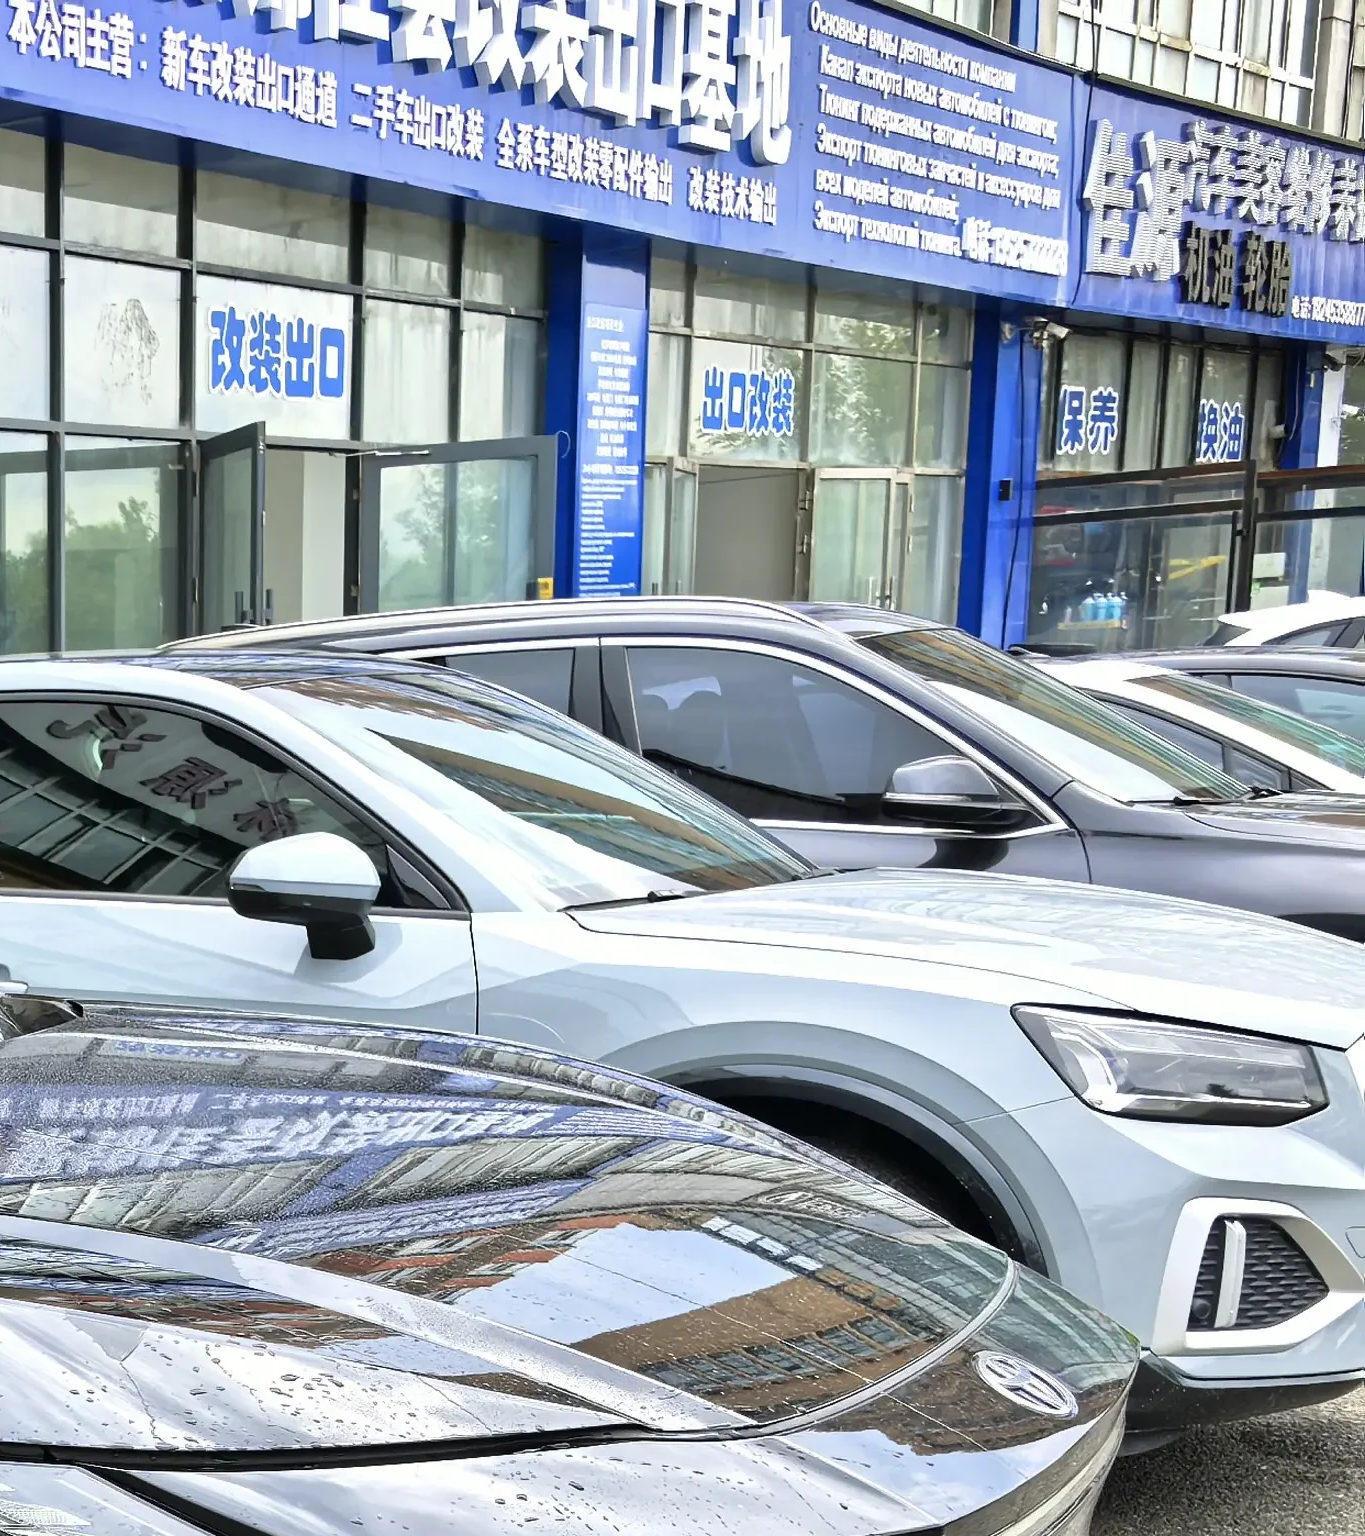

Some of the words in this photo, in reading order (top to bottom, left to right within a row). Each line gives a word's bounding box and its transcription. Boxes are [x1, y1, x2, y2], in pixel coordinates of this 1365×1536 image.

[811, 0, 867, 47] Основные
[869, 25, 898, 60] виды
[898, 37, 969, 79] деятельности
[821, 45, 854, 83] Канал
[855, 62, 902, 99] экспорта
[904, 78, 938, 107] новых
[939, 89, 1002, 124] автомобилей
[161, 26, 338, 128] 新车改装出口通道
[350, 83, 484, 160] 二手车出口改装
[687, 166, 777, 226] 改装技术输出
[816, 122, 861, 167] Экспорт
[819, 84, 861, 122] Тюнинг
[933, 124, 997, 159] автомобилей
[815, 169, 842, 195] всех
[814, 200, 860, 243] Экспорт
[1182, 221, 1233, 309] 机油
[208, 304, 346, 398] 改装出口
[701, 365, 795, 437] 出口改装
[1056, 384, 1119, 455] 保养
[1196, 398, 1245, 463] 换油
